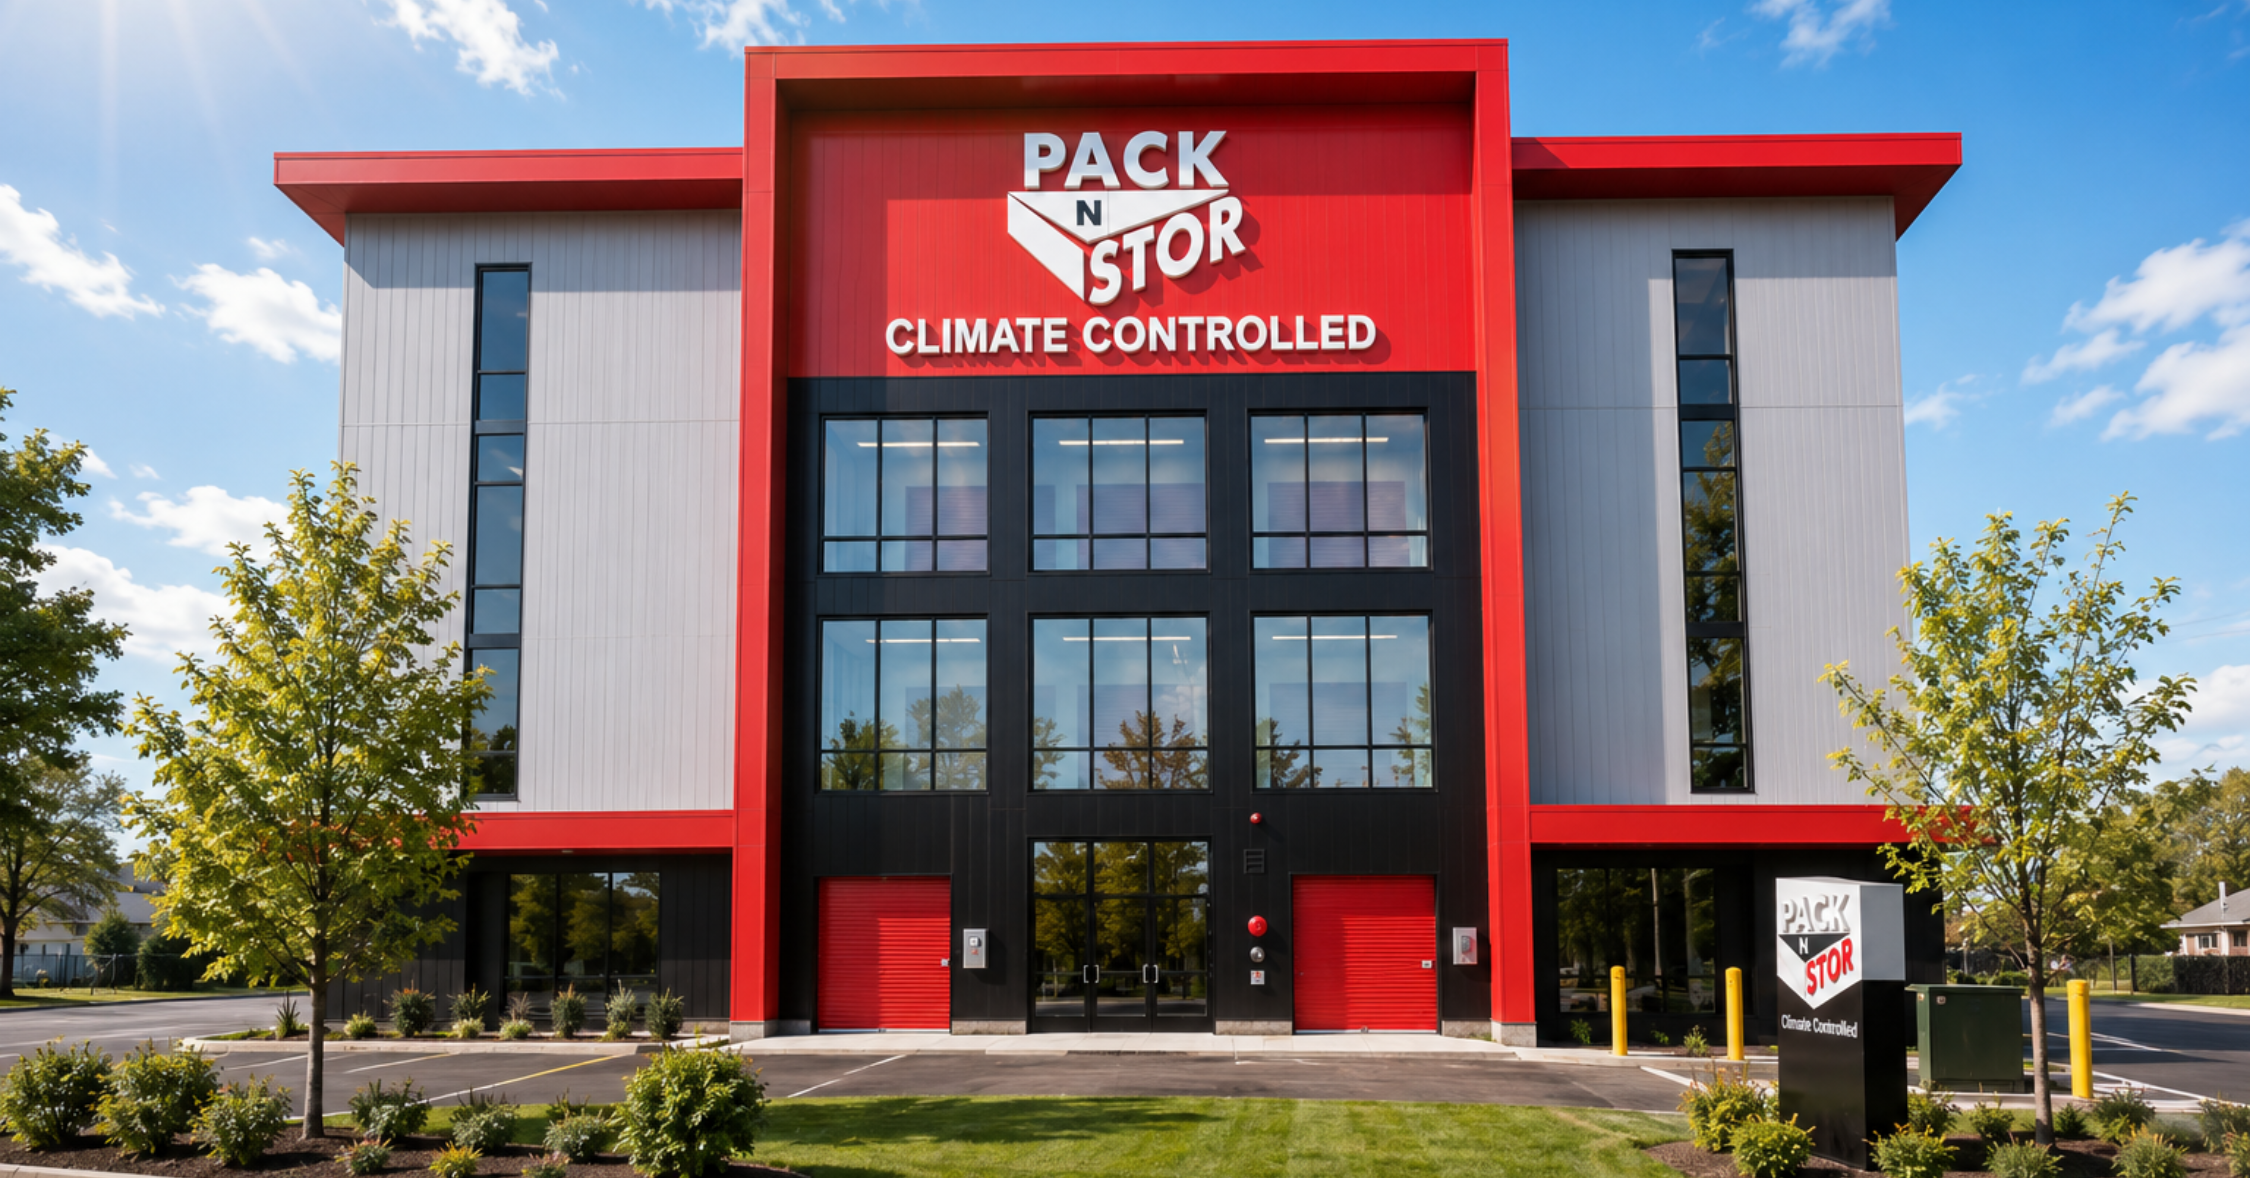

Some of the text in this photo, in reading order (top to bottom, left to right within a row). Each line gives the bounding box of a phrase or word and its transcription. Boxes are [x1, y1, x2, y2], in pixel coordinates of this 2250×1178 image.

[1023, 130, 1229, 190] PACK
[1076, 199, 1102, 226] N
[1088, 196, 1246, 305] STOR
[885, 315, 1376, 354] CLIMATE CONTROLLED
[1781, 894, 1850, 933] PACK
[1799, 937, 1808, 955] N
[1806, 938, 1853, 996] STOR
[1781, 1014, 1858, 1038] Climate Controlled
